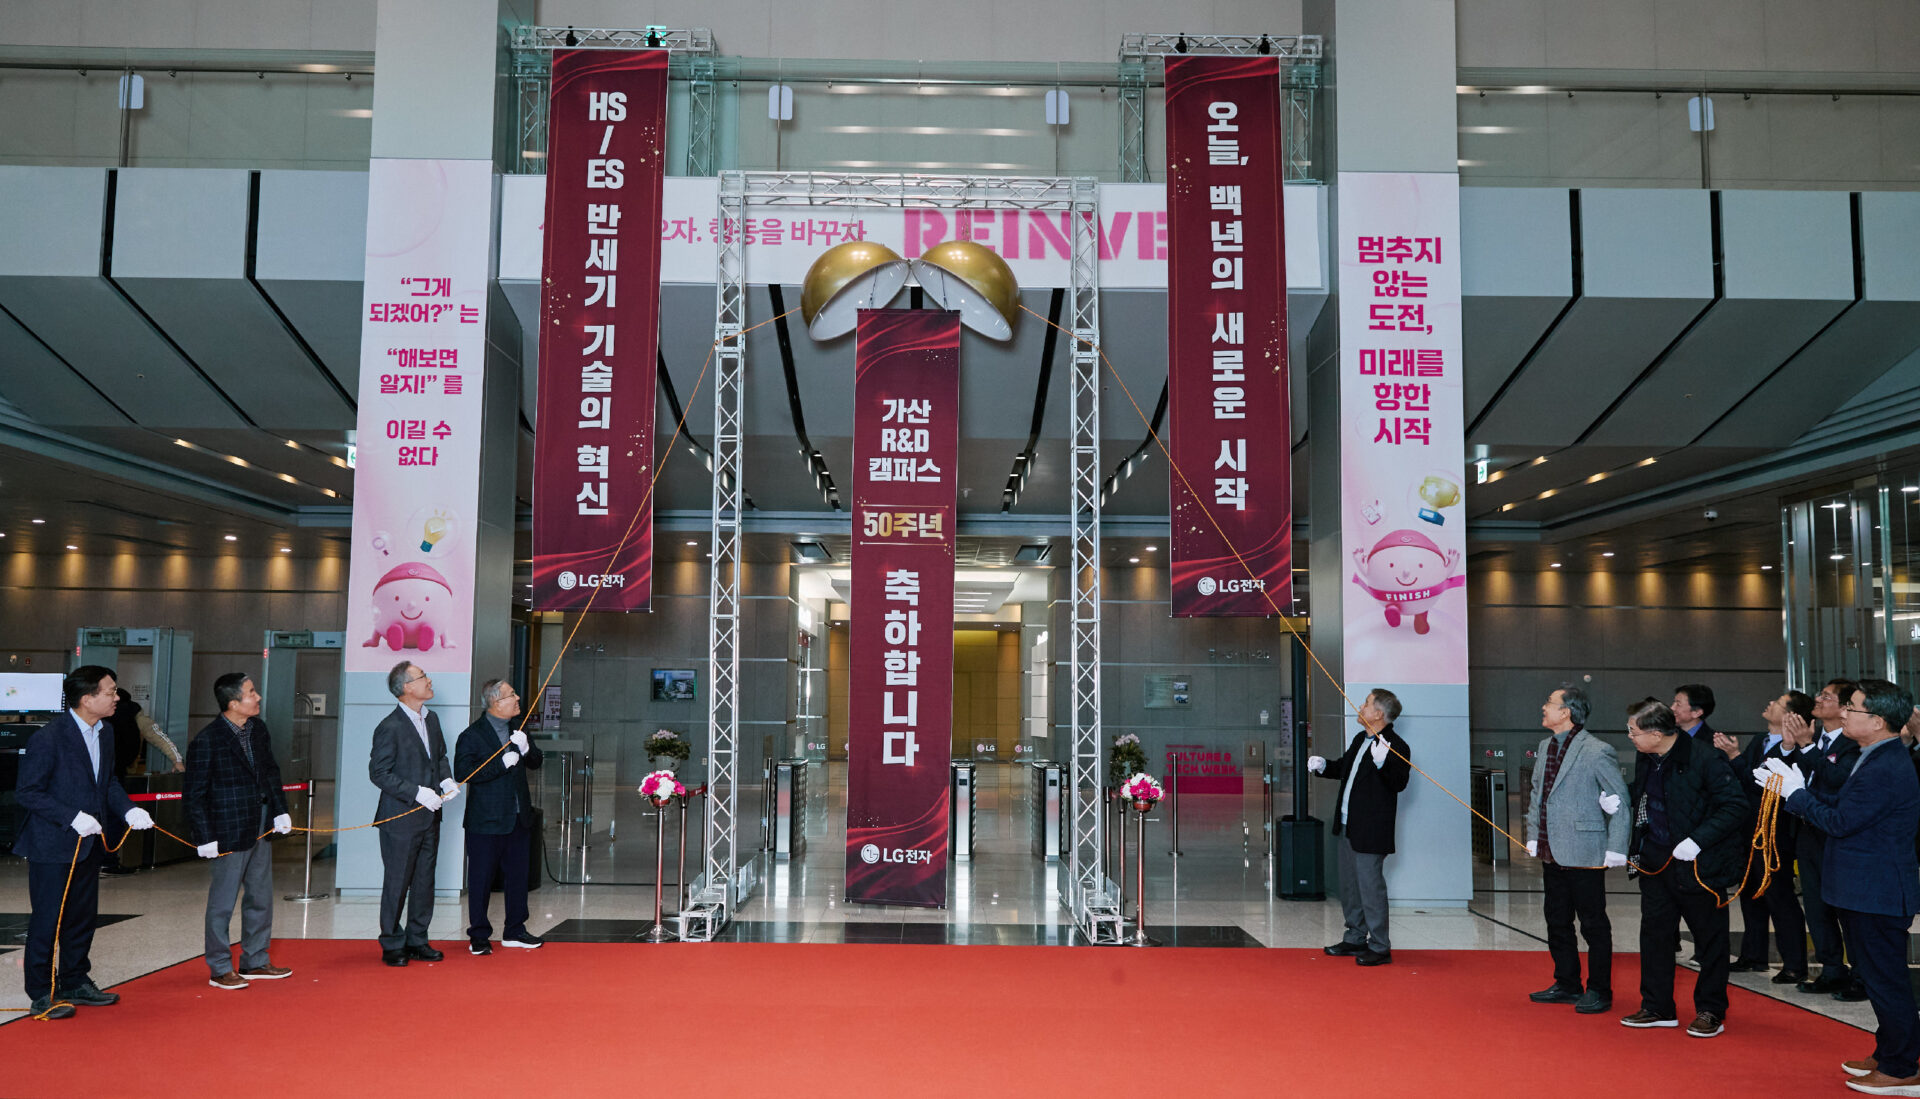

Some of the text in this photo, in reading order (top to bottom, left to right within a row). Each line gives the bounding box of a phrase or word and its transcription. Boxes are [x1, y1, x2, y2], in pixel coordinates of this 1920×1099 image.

[791, 218, 867, 247] 바꾸자
[583, 204, 621, 307] 반세기
[1358, 236, 1442, 264] 멈추지
[400, 277, 451, 297] “그게
[1373, 270, 1428, 298] 않는
[369, 303, 479, 323] 되겠어?” 는
[1208, 102, 1248, 510] 오늘, 백년의 새로운 시작
[1369, 304, 1433, 335] 도전,
[387, 348, 458, 369] “해보면
[1359, 349, 1444, 377] 미래를
[380, 374, 463, 395] 알지!” 를
[579, 325, 615, 428] 기술의
[1373, 383, 1431, 411] 향한
[882, 398, 932, 424] 가산
[386, 420, 452, 440] 이길 수
[881, 428, 930, 453] R&D
[1374, 417, 1432, 445] 시작
[398, 446, 439, 466] 없다
[577, 443, 610, 515] 혁신
[869, 458, 941, 483] 캠퍼스
[863, 512, 943, 539] 50주년
[579, 574, 625, 588] LG전자
[1219, 579, 1266, 593] LG전자
[1385, 590, 1430, 601] FINISH
[883, 568, 921, 767] 축하합니다
[883, 847, 933, 865] LG전자
